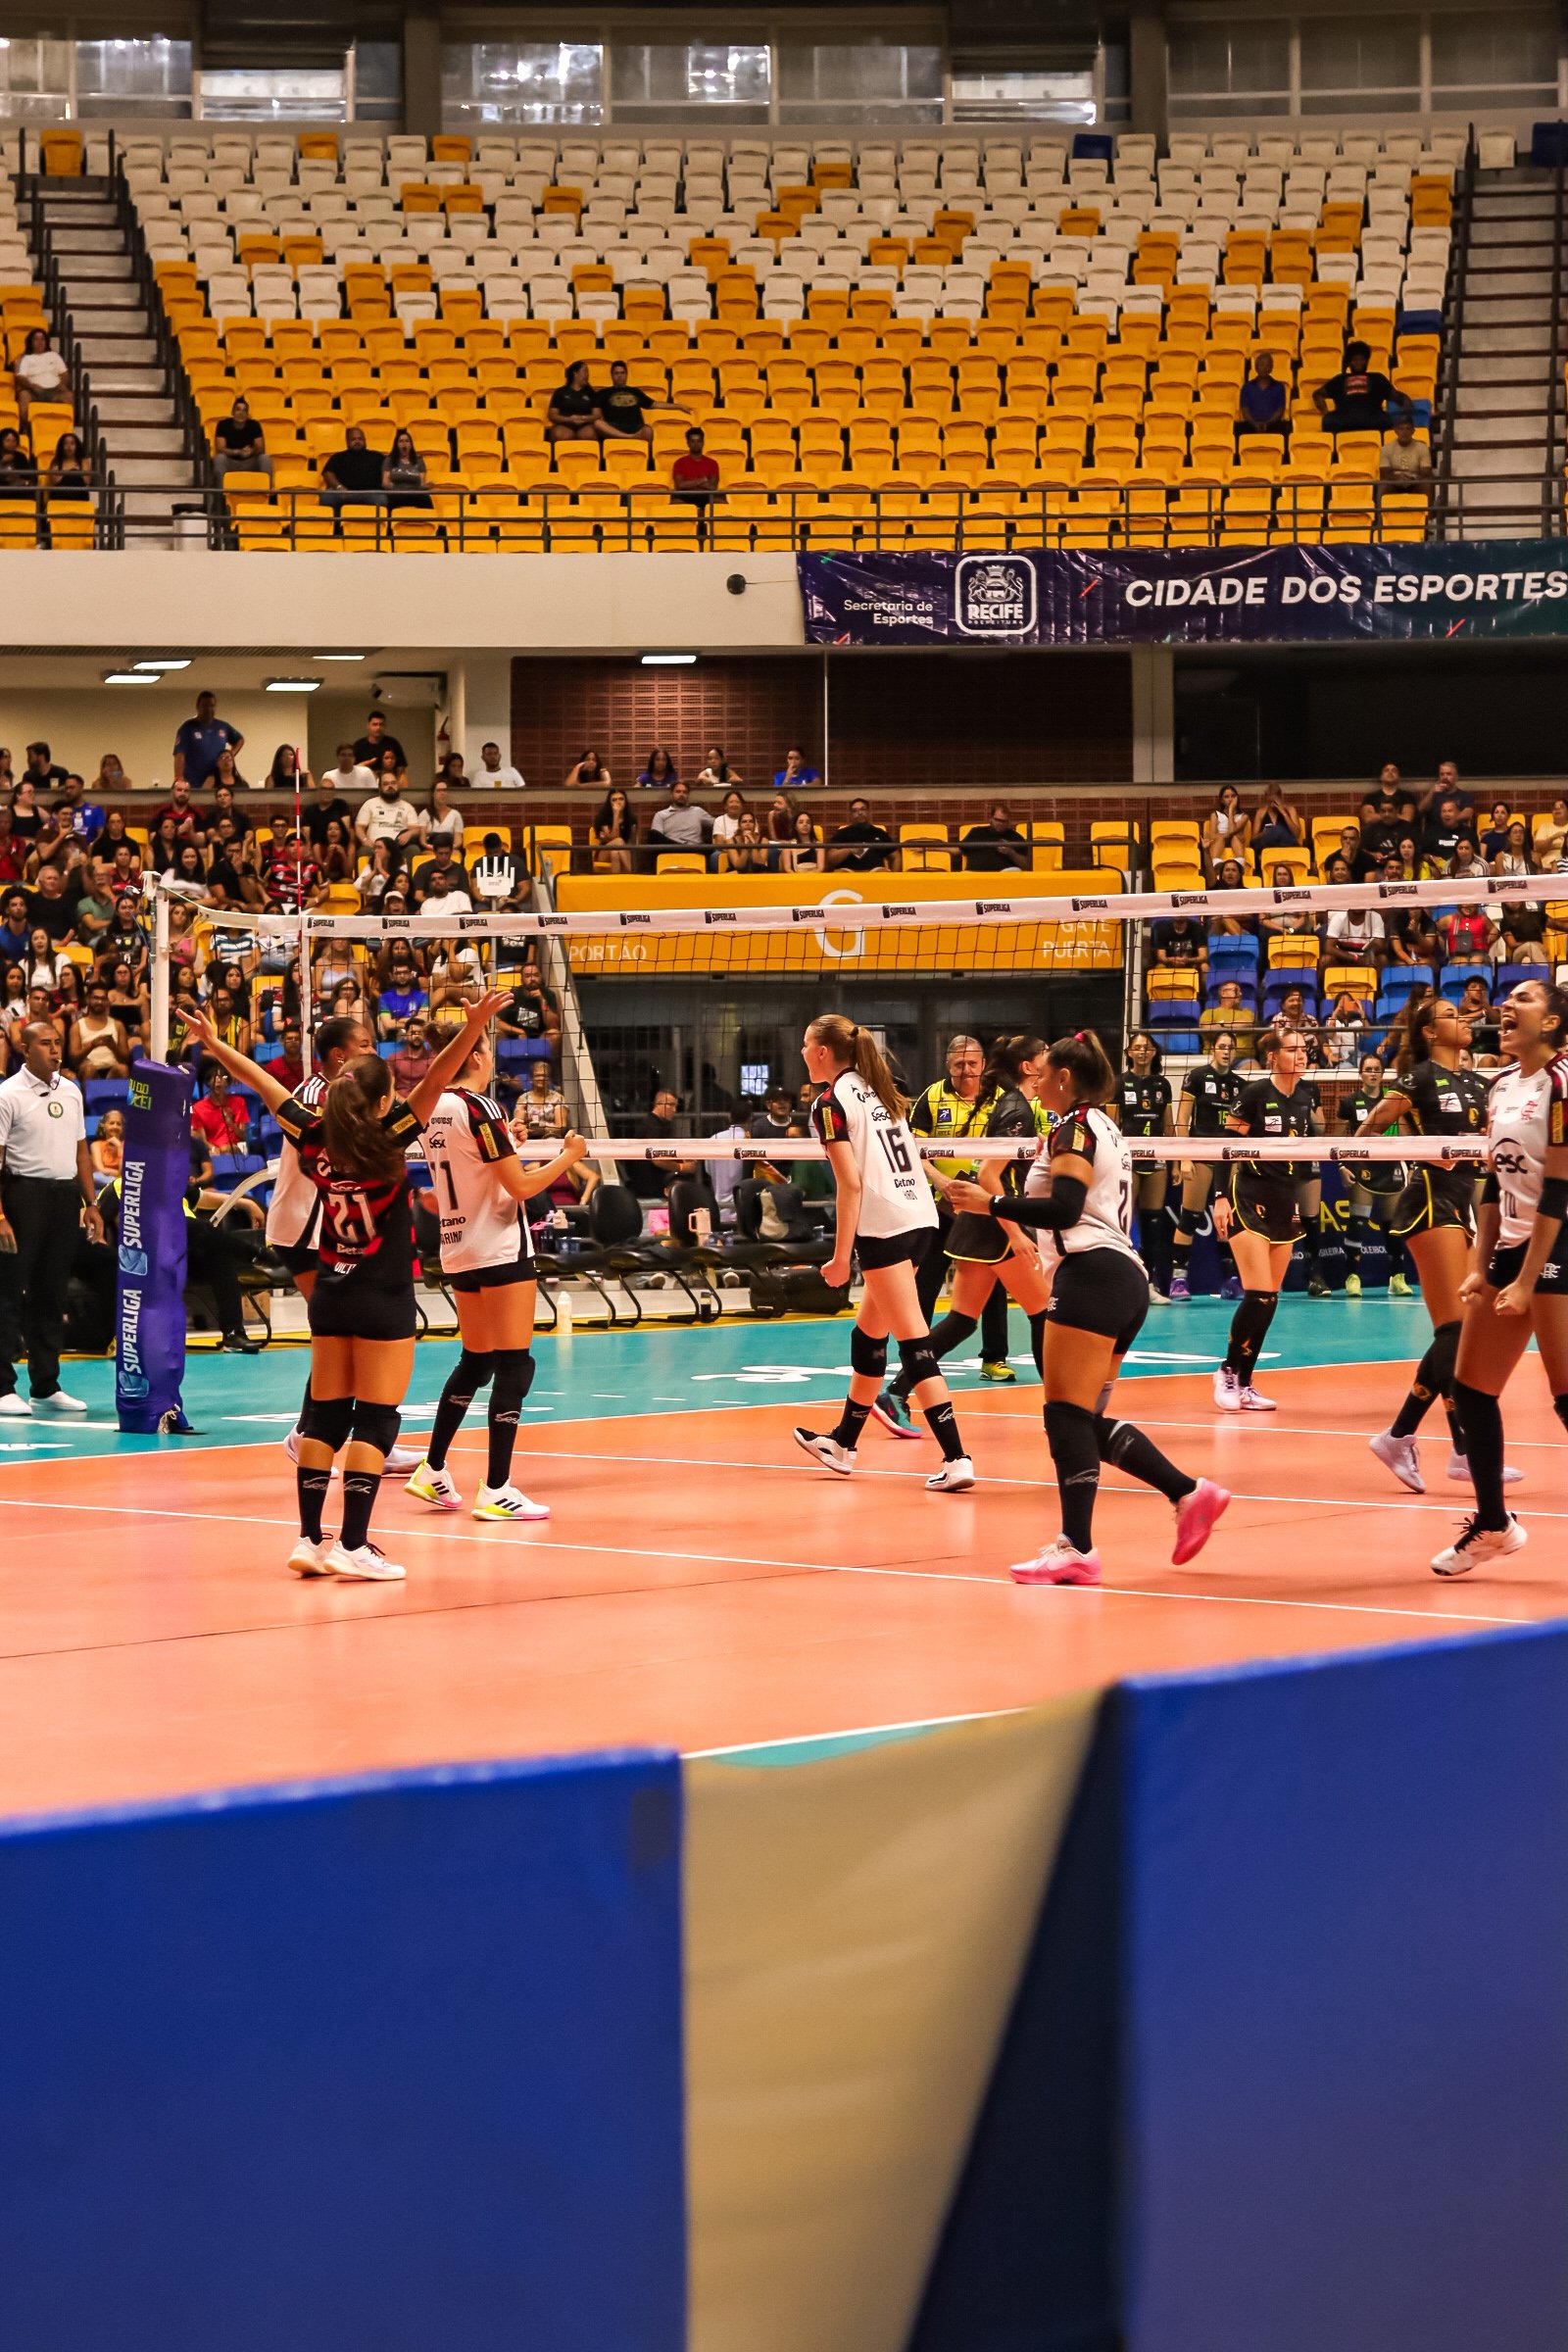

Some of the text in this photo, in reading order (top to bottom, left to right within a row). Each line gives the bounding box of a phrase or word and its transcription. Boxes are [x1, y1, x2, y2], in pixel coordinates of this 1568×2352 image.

[1125, 569, 1568, 607] CIDADE DOS ESPORTES
[844, 599, 933, 612] Secretaria de
[967, 603, 1023, 619] RECIFE
[874, 612, 933, 627] Esportes
[1388, 884, 1418, 896] SUPERLIGA
[1495, 879, 1528, 892] SUPERLIGA
[1179, 894, 1208, 906] SUPERLIGA
[1282, 890, 1311, 902] SUPERLIGA
[983, 903, 1011, 913] SUPERLIGA
[1079, 899, 1108, 910] SUPERLIGA
[711, 911, 737, 922] SUPERLIGA
[799, 908, 824, 920] SUPERLIGA
[890, 906, 916, 917] SUPERLIGA
[313, 918, 335, 928] SUPERLIGA
[388, 919, 410, 928] SUPERLIGA
[466, 917, 488, 928] SUPERLIGA
[544, 915, 568, 926] SUPERLIGA
[626, 913, 651, 923] SUPERLIGA
[568, 941, 647, 961] PORTÃO
[1043, 941, 1110, 957] PUERTA
[653, 1150, 677, 1158] SUPERLIGA
[741, 1150, 766, 1158] SUPERLIGA
[876, 1126, 912, 1173] 16
[928, 1150, 955, 1158] SUPERLIGA
[1130, 1150, 1155, 1158] UPERLIGA
[1231, 1150, 1260, 1159] SUPERLIGA
[1339, 1150, 1370, 1159] SUPERLIGA
[1450, 1149, 1483, 1159] SUPERLIGA
[123, 1160, 146, 1249] SUPERLIGA
[328, 1193, 376, 1244] 21
[440, 1216, 466, 1227] tano
[122, 1289, 142, 1374] SUPERLIGA
